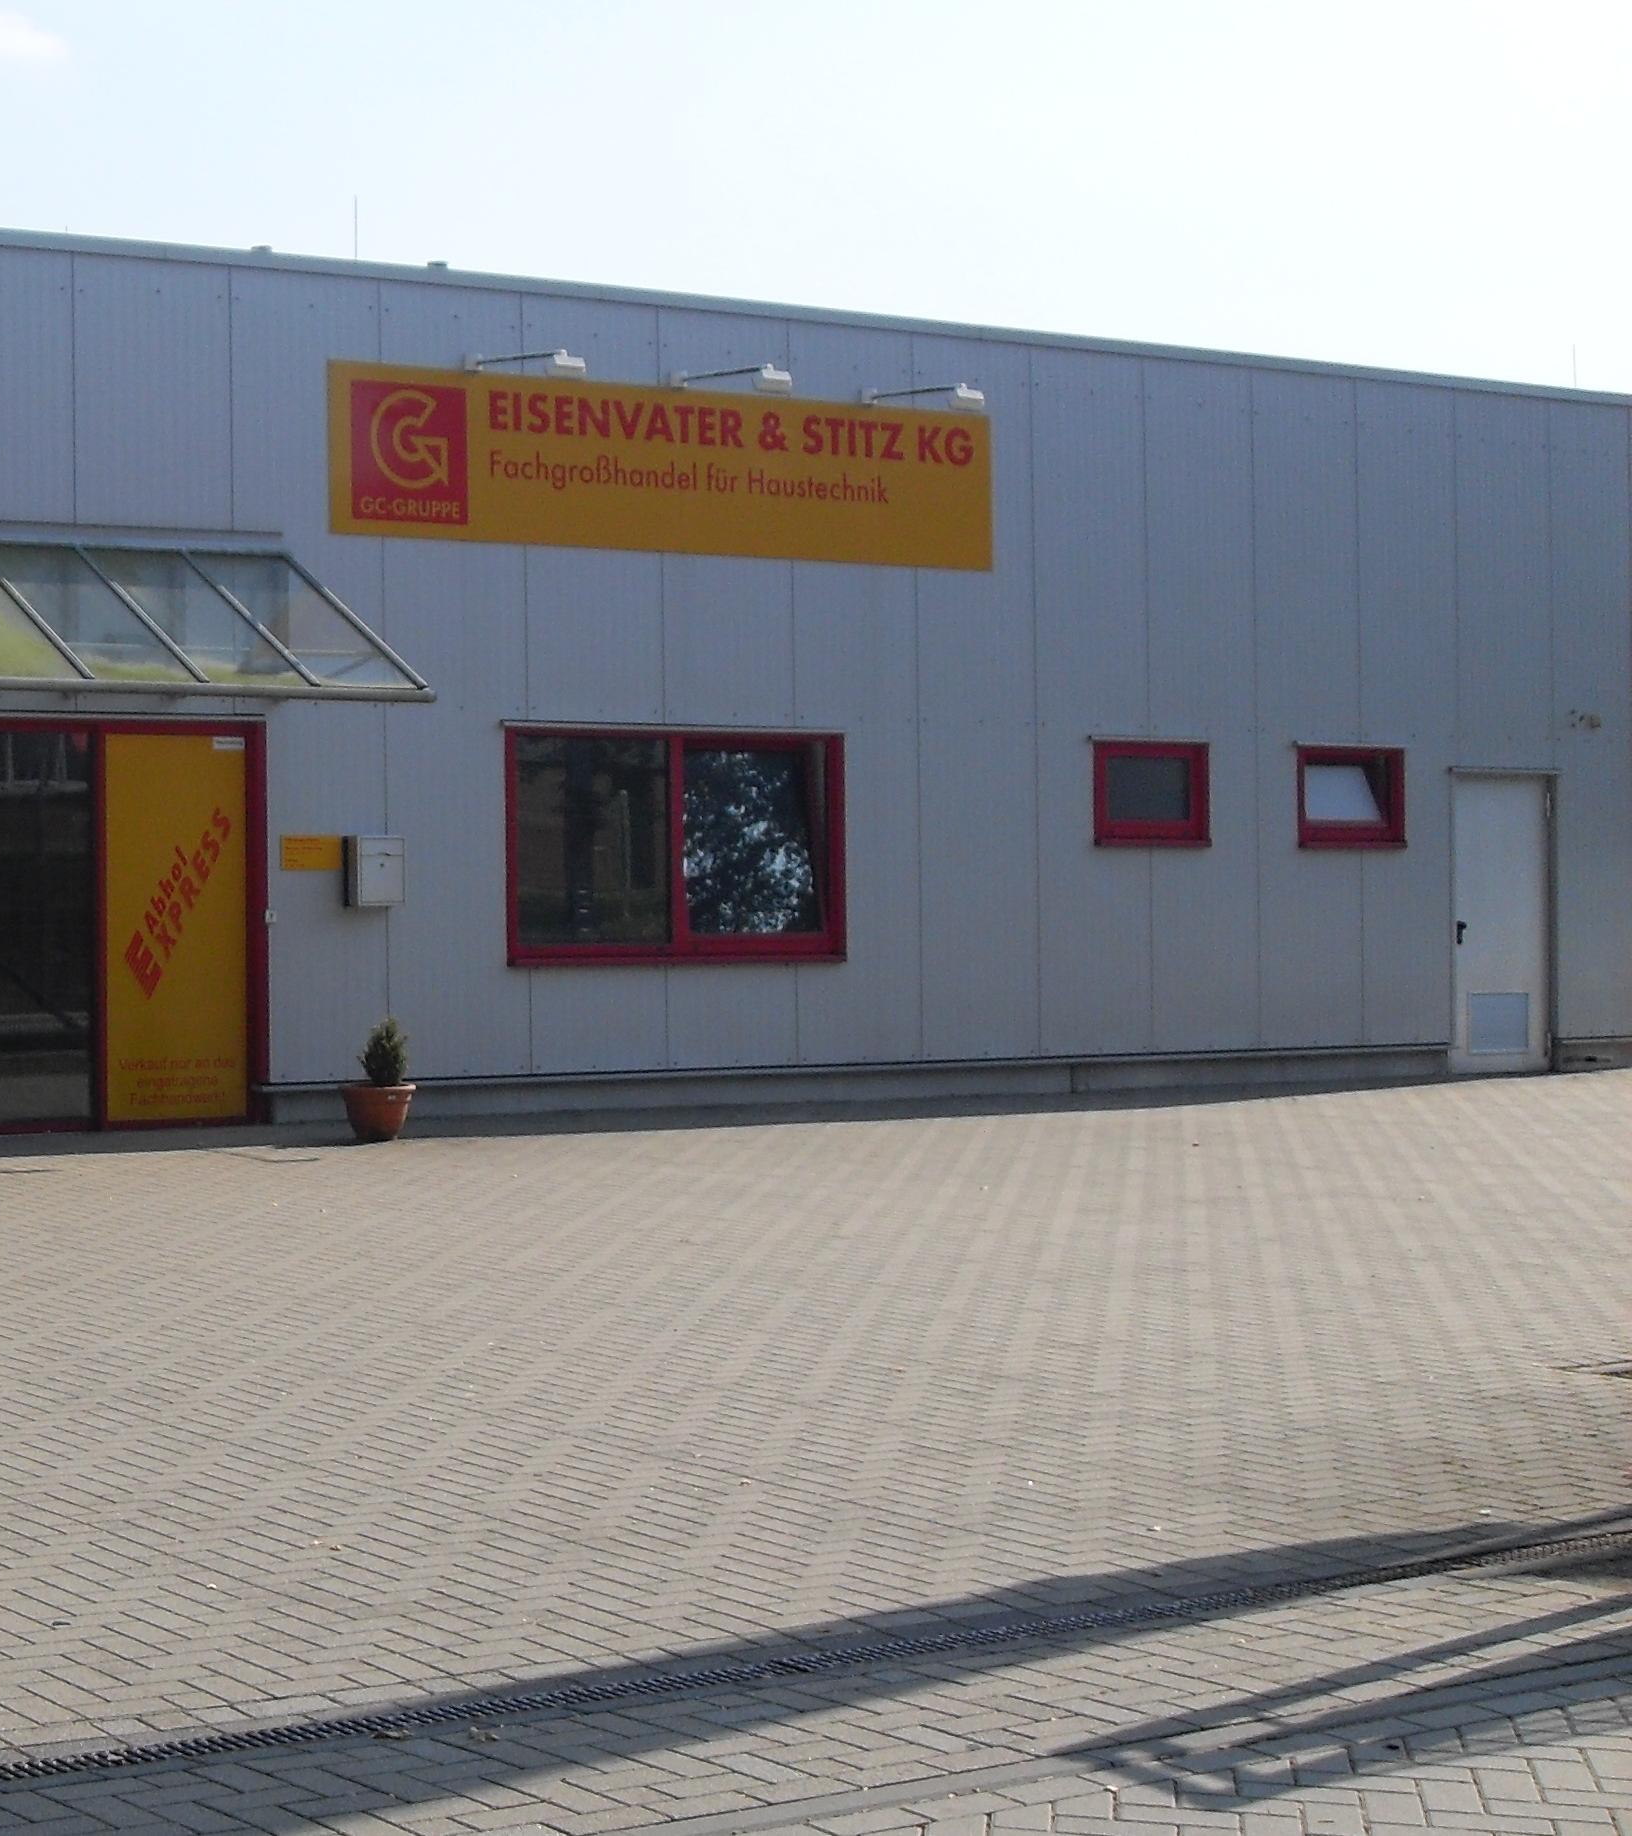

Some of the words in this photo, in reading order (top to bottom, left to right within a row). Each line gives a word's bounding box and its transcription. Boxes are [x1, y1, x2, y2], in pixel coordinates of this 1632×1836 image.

[488, 390, 744, 448] EISENVATER
[758, 411, 789, 451] &
[802, 414, 905, 461] STITZ
[918, 425, 974, 466] KG
[361, 496, 461, 519] GC-GRUPPE
[489, 450, 698, 492] Fachgroßhandel
[707, 462, 738, 495] für
[747, 467, 889, 504] Haustechnik
[125, 807, 232, 1000] EXPRESS
[144, 846, 188, 935] Abhol
